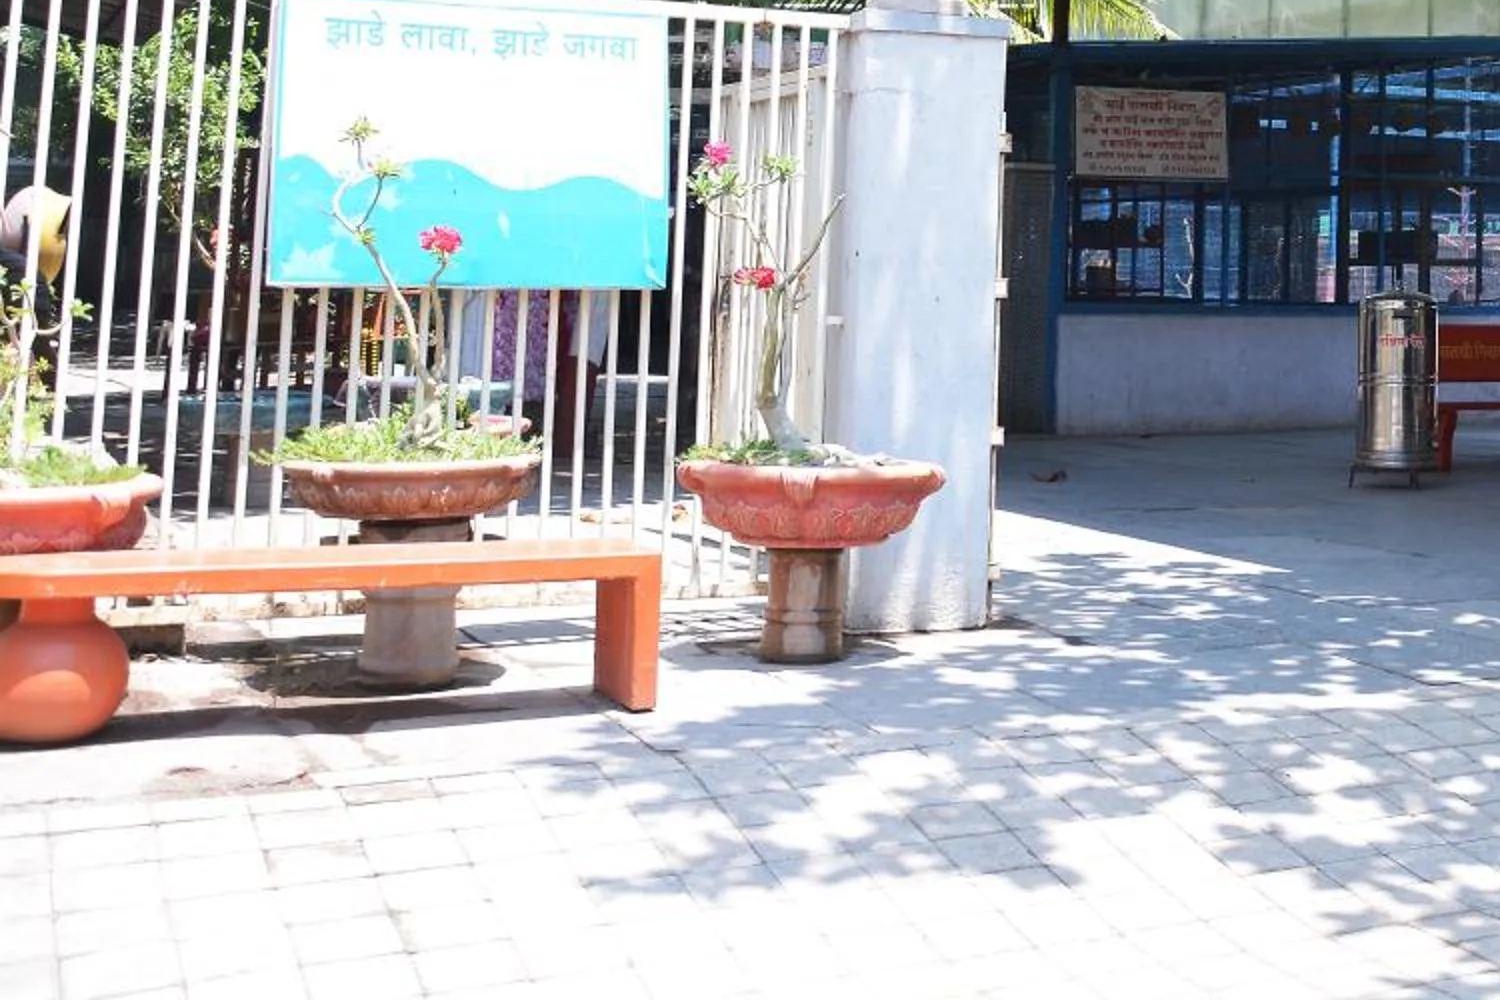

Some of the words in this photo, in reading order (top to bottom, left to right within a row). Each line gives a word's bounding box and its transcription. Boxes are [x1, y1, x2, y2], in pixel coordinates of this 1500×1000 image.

[325, 10, 387, 50] झाडे
[400, 22, 477, 56] लावा,
[493, 21, 551, 61] झाडे
[562, 32, 640, 63] जगवा
